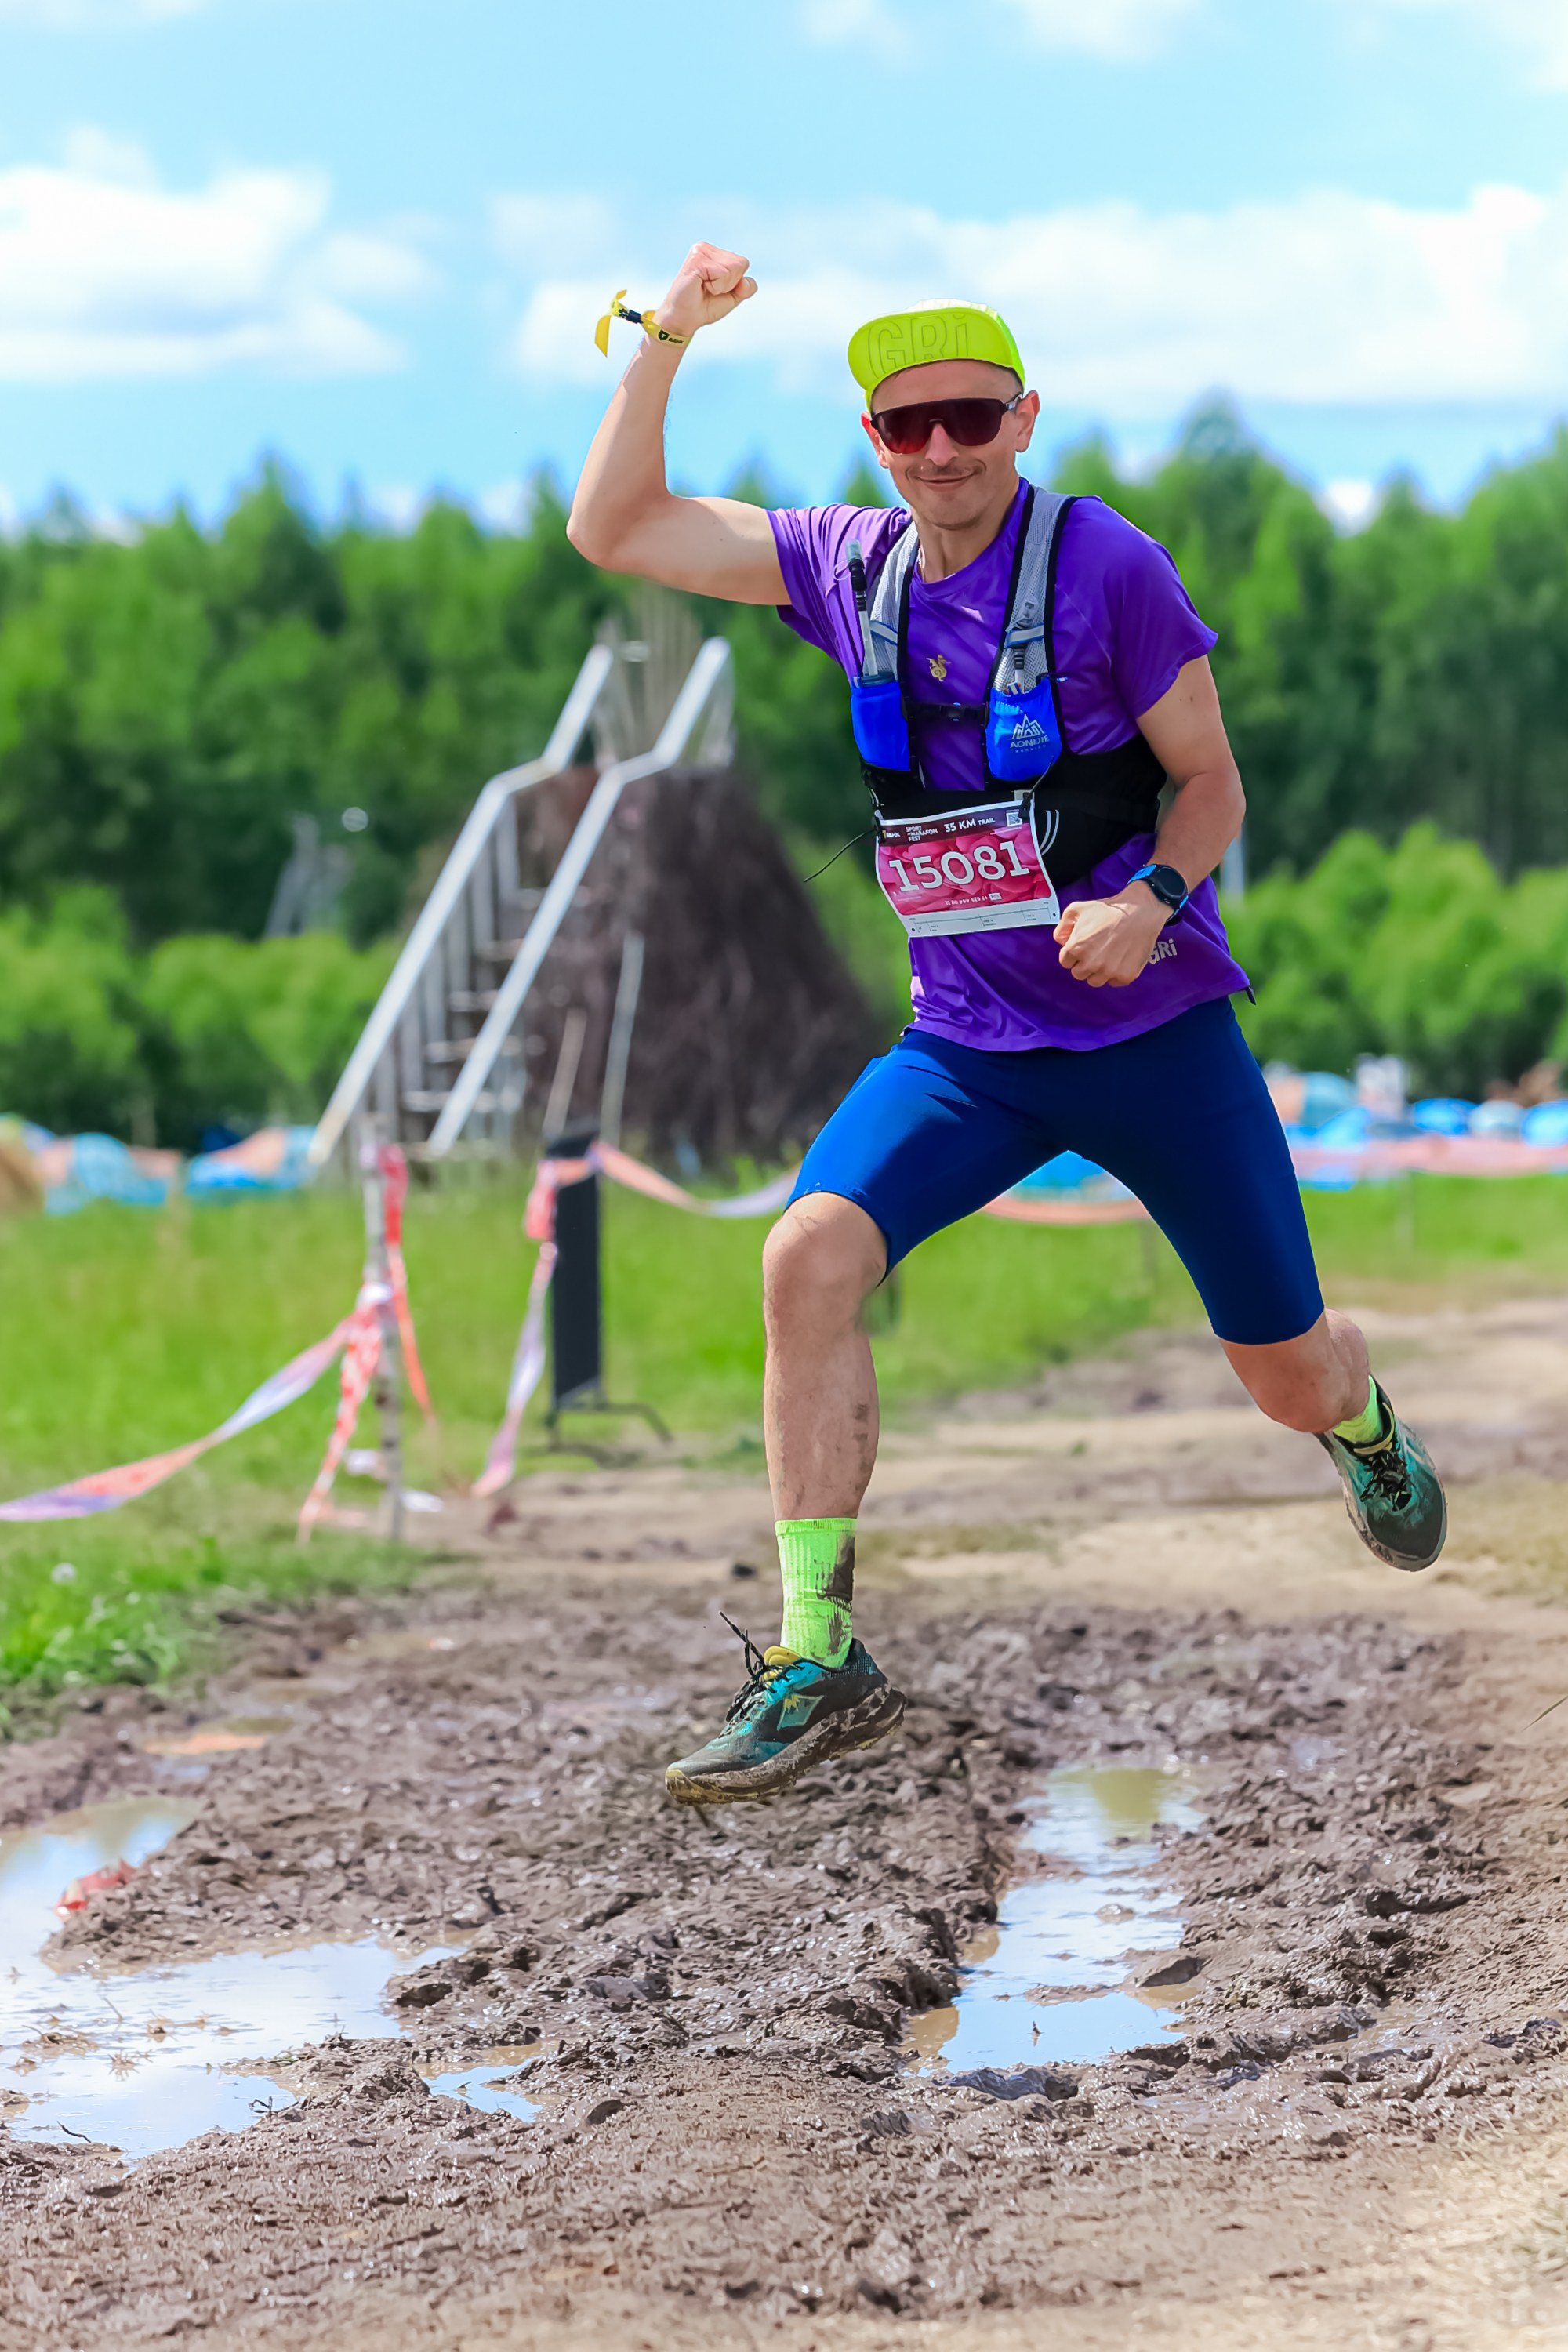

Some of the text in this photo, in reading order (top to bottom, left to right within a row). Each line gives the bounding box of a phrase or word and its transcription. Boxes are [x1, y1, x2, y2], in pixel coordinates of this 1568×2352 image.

[1010, 735, 1049, 748] AONIJIE
[943, 817, 996, 833] 35 KM TRAIL
[889, 841, 1029, 892] 15081
